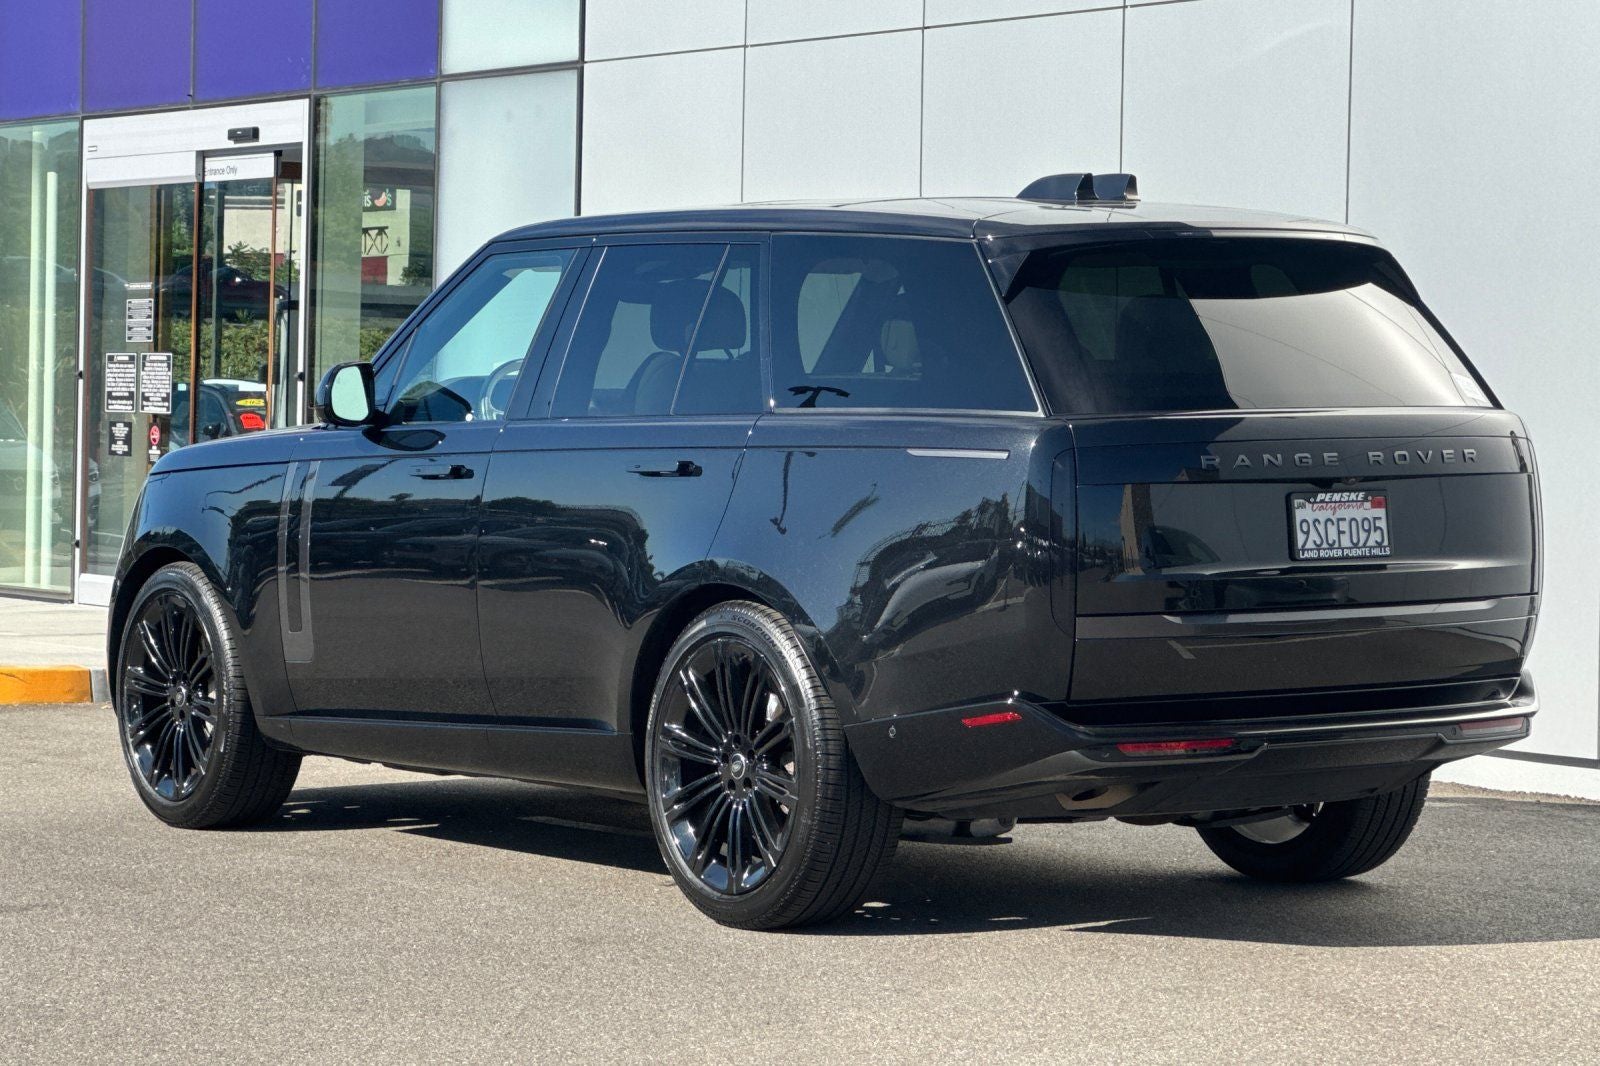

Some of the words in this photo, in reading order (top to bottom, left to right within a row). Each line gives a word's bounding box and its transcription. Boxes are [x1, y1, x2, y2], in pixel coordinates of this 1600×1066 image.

[226, 165, 238, 176] Only
[1200, 452, 1340, 471] RANGE
[1367, 448, 1479, 466] ROVER
[1316, 492, 1366, 502] PENSKE
[1311, 501, 1365, 516] California
[1299, 516, 1385, 549] 9SCF095
[1300, 549, 1319, 559] LAND
[1320, 549, 1342, 558] ROVER
[1343, 548, 1371, 557] PUENTE
[1372, 547, 1391, 556] HILLS
[731, 614, 778, 648] SCORPION
